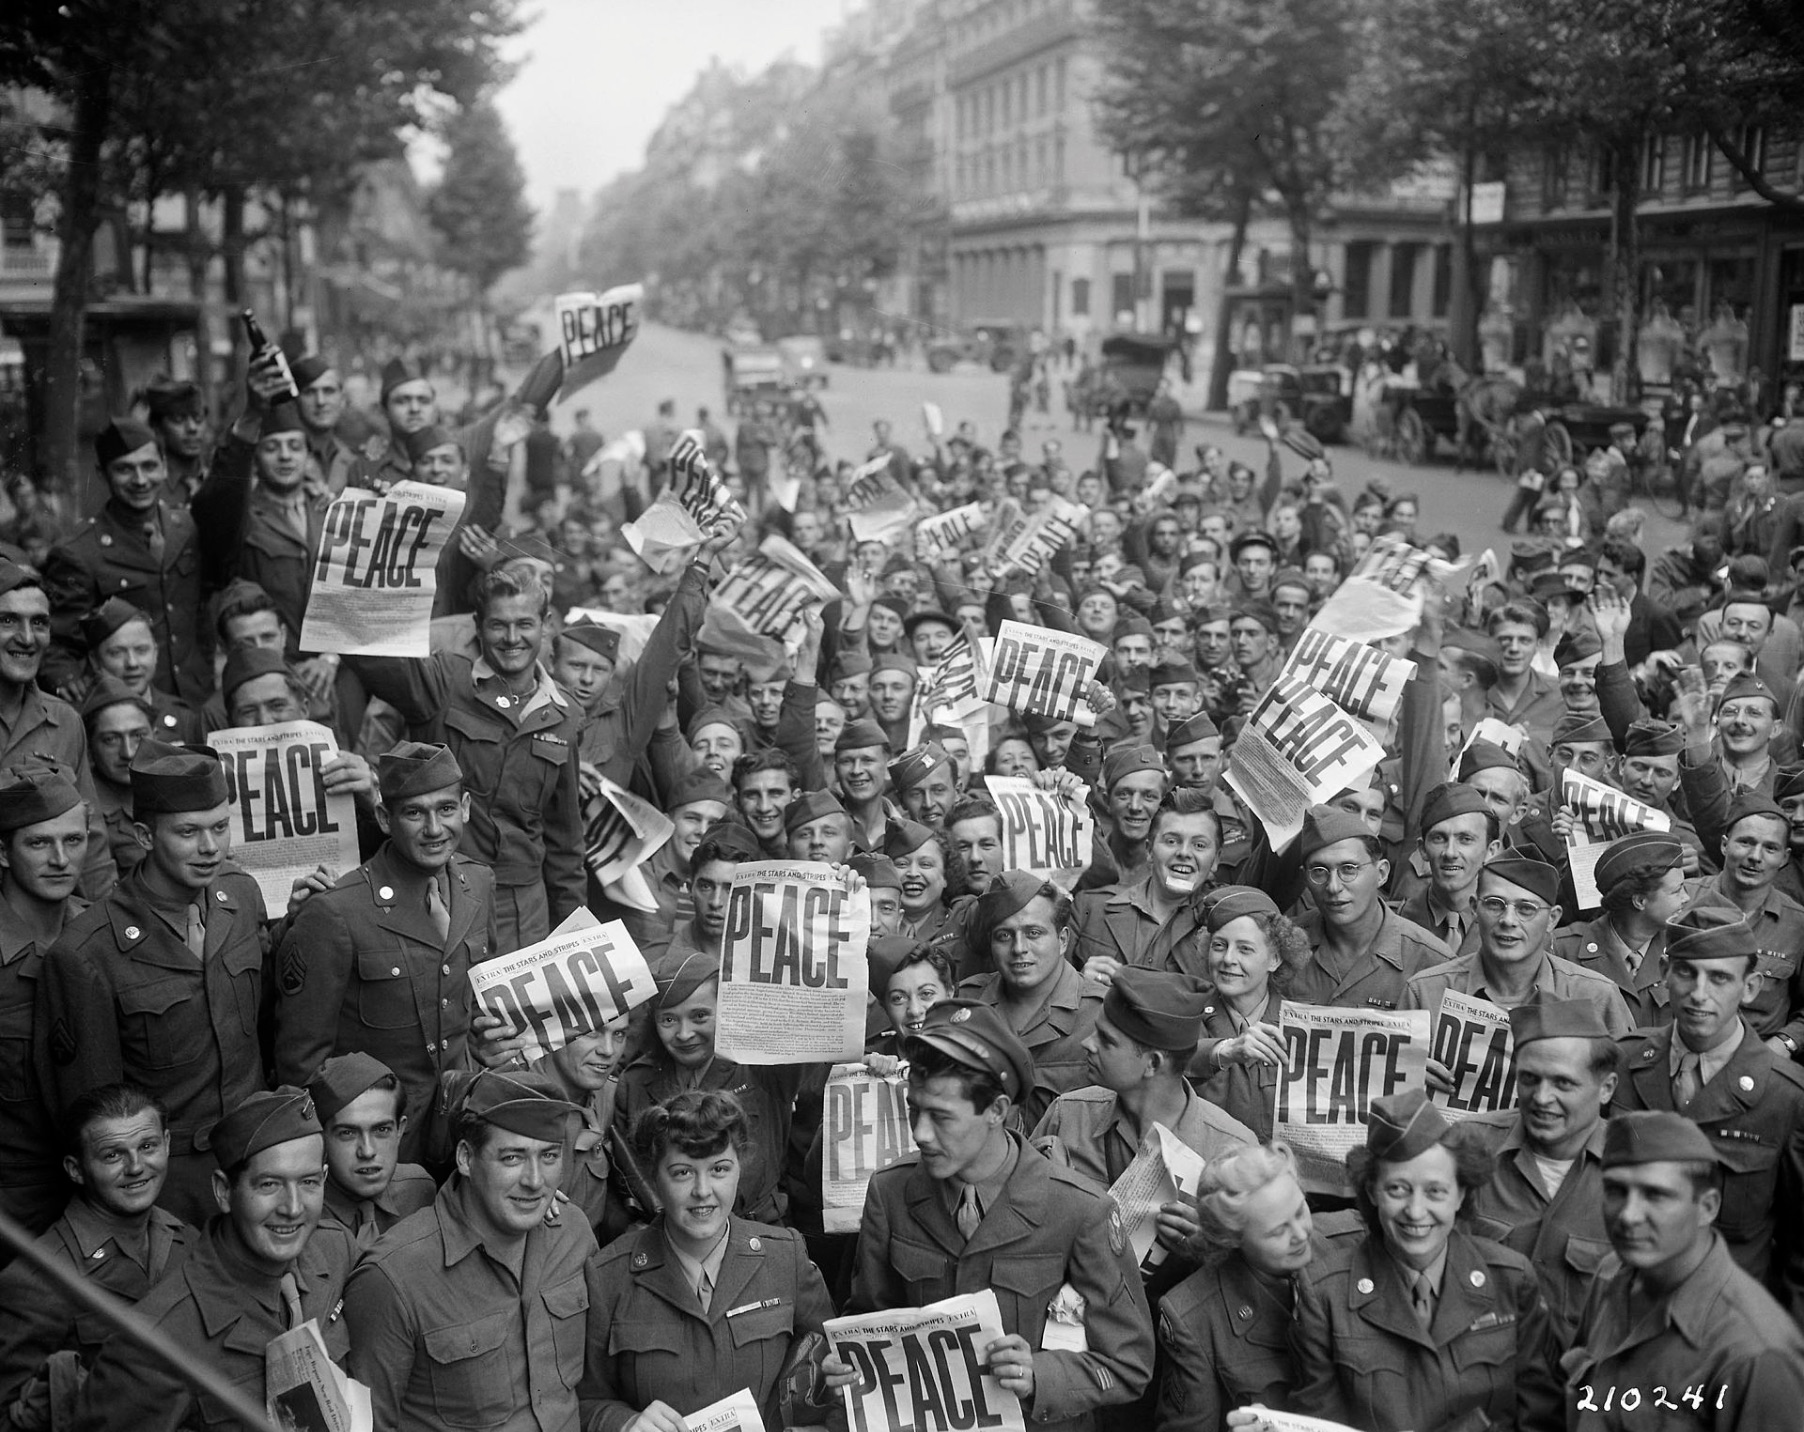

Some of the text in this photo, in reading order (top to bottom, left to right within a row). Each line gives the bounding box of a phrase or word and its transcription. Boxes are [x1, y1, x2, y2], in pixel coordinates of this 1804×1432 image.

[561, 302, 633, 368] PEACE
[317, 499, 445, 588] PEACE
[987, 638, 1093, 722] PEACE
[1287, 630, 1393, 723] PEACE
[1250, 674, 1368, 788] PEACE
[998, 793, 1083, 870] PEACE
[768, 870, 786, 878] STARS
[787, 871, 802, 879] AND
[802, 872, 827, 881] STRIPES
[476, 932, 607, 984] EXTRA THE STARS AND STRIPES EXTRA
[722, 883, 850, 989] PEACE
[481, 942, 634, 1051] PEACE
[1310, 1014, 1322, 1023] THE
[1323, 1015, 1343, 1025] STARS
[1359, 1018, 1385, 1028] STRIPES
[1443, 998, 1465, 1012] EXTRA
[1467, 1006, 1477, 1016] THE
[1478, 1010, 1498, 1022] STARS
[1278, 1025, 1411, 1125] PEACE
[1426, 1012, 1519, 1113] PEA
[829, 1081, 910, 1181] PEAC
[862, 1327, 875, 1335] THE
[875, 1325, 899, 1334] STARS
[899, 1324, 915, 1333] AND
[916, 1317, 945, 1329] STRIPES
[709, 1410, 736, 1427] EXTRA
[836, 1323, 1003, 1432] PEACE
